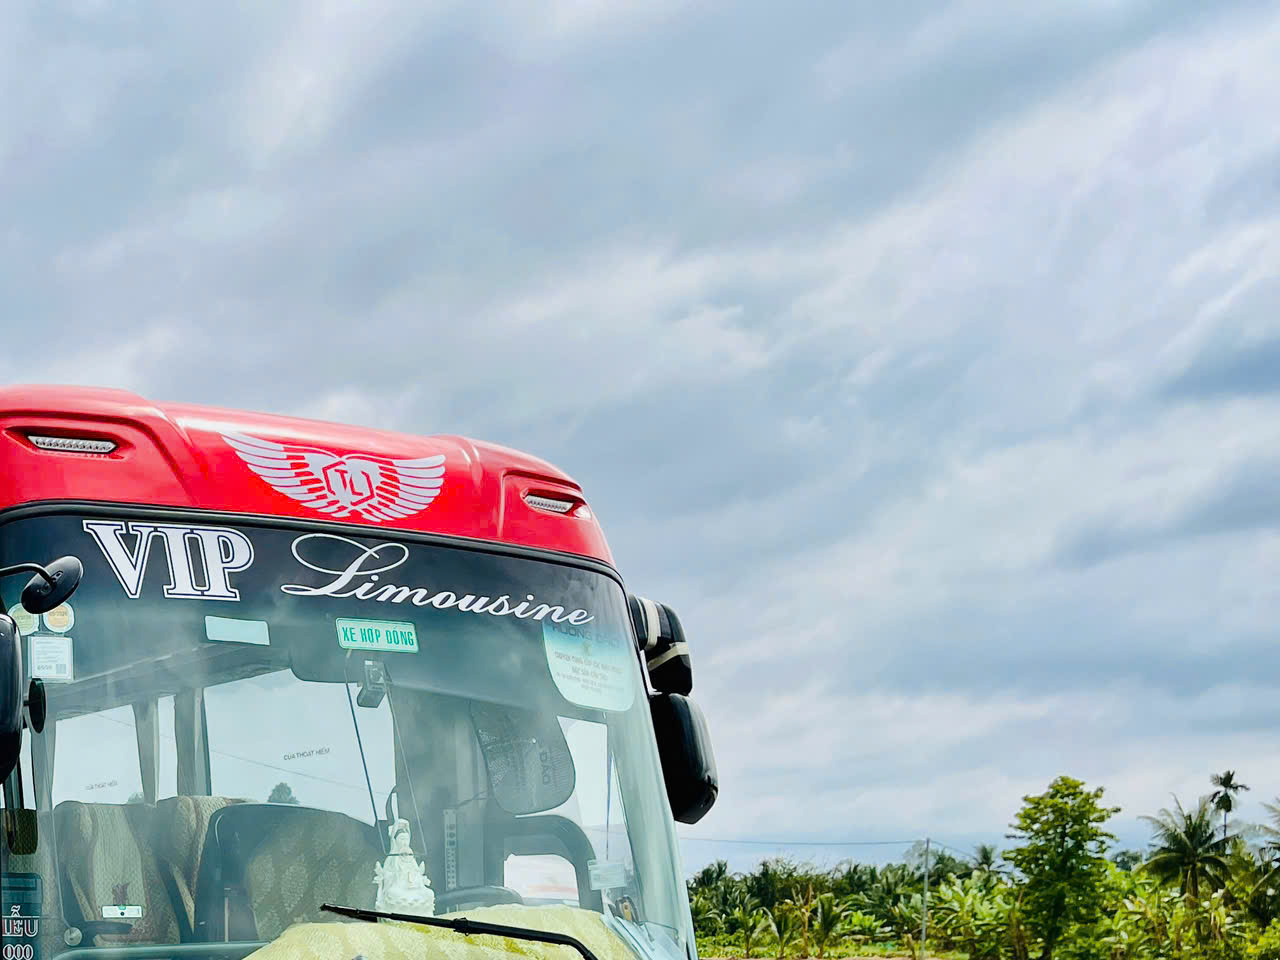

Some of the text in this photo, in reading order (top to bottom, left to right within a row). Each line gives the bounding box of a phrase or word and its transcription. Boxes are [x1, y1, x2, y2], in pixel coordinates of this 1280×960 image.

[83, 520, 595, 627] VIP Limousine
[342, 626, 358, 642] XE
